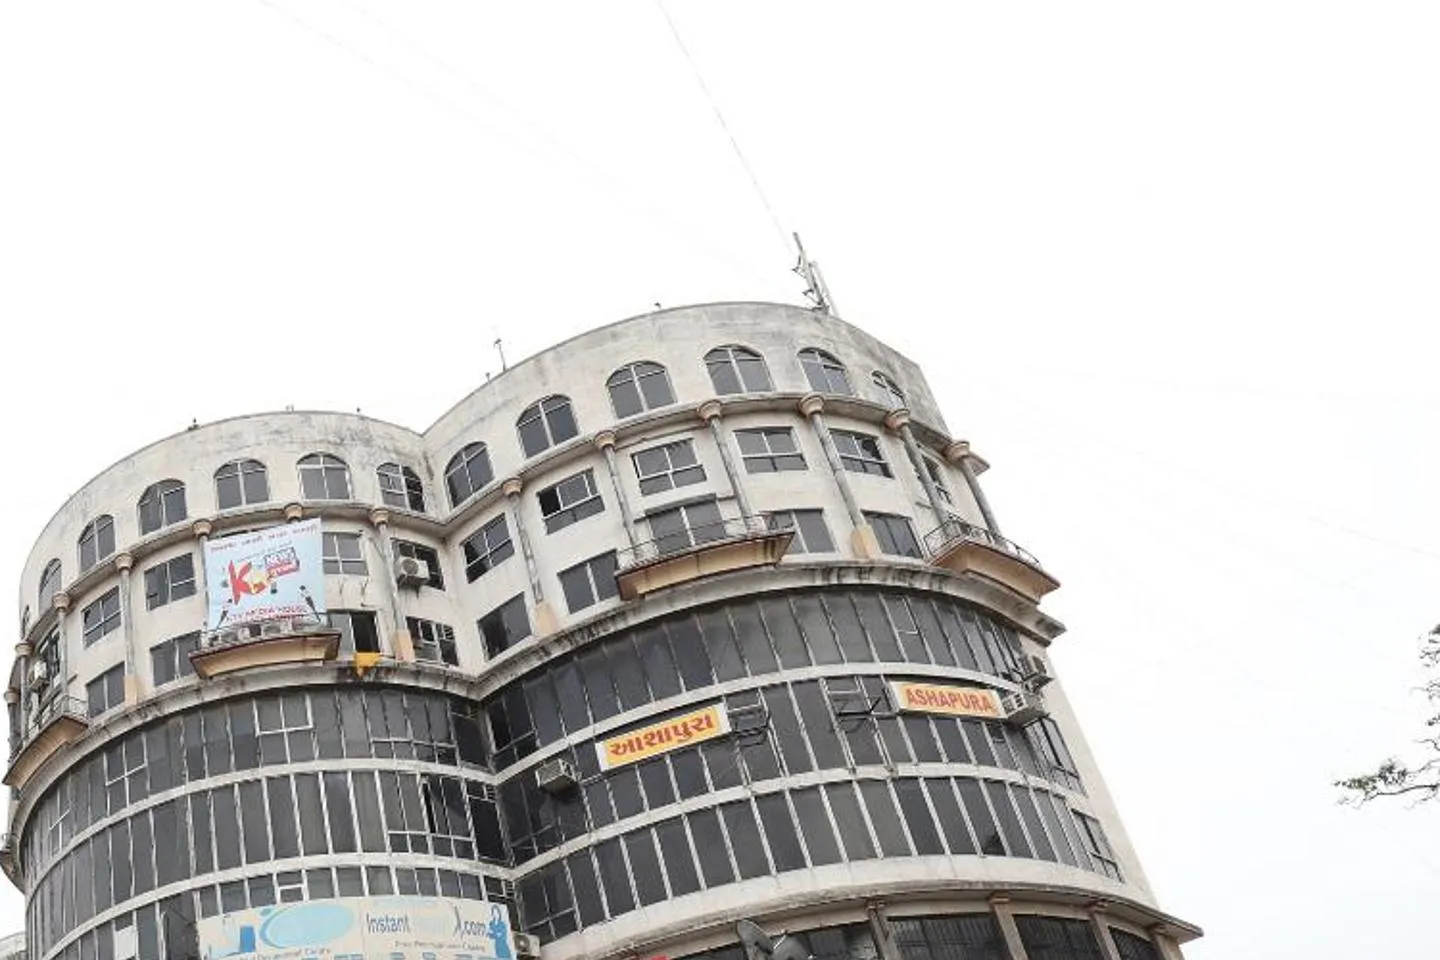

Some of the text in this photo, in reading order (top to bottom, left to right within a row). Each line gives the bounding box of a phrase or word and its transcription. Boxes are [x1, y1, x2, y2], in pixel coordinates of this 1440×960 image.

[905, 686, 995, 714] ASHAPURA
[609, 714, 715, 758] આશાપુરા
[366, 913, 410, 935] Instant
